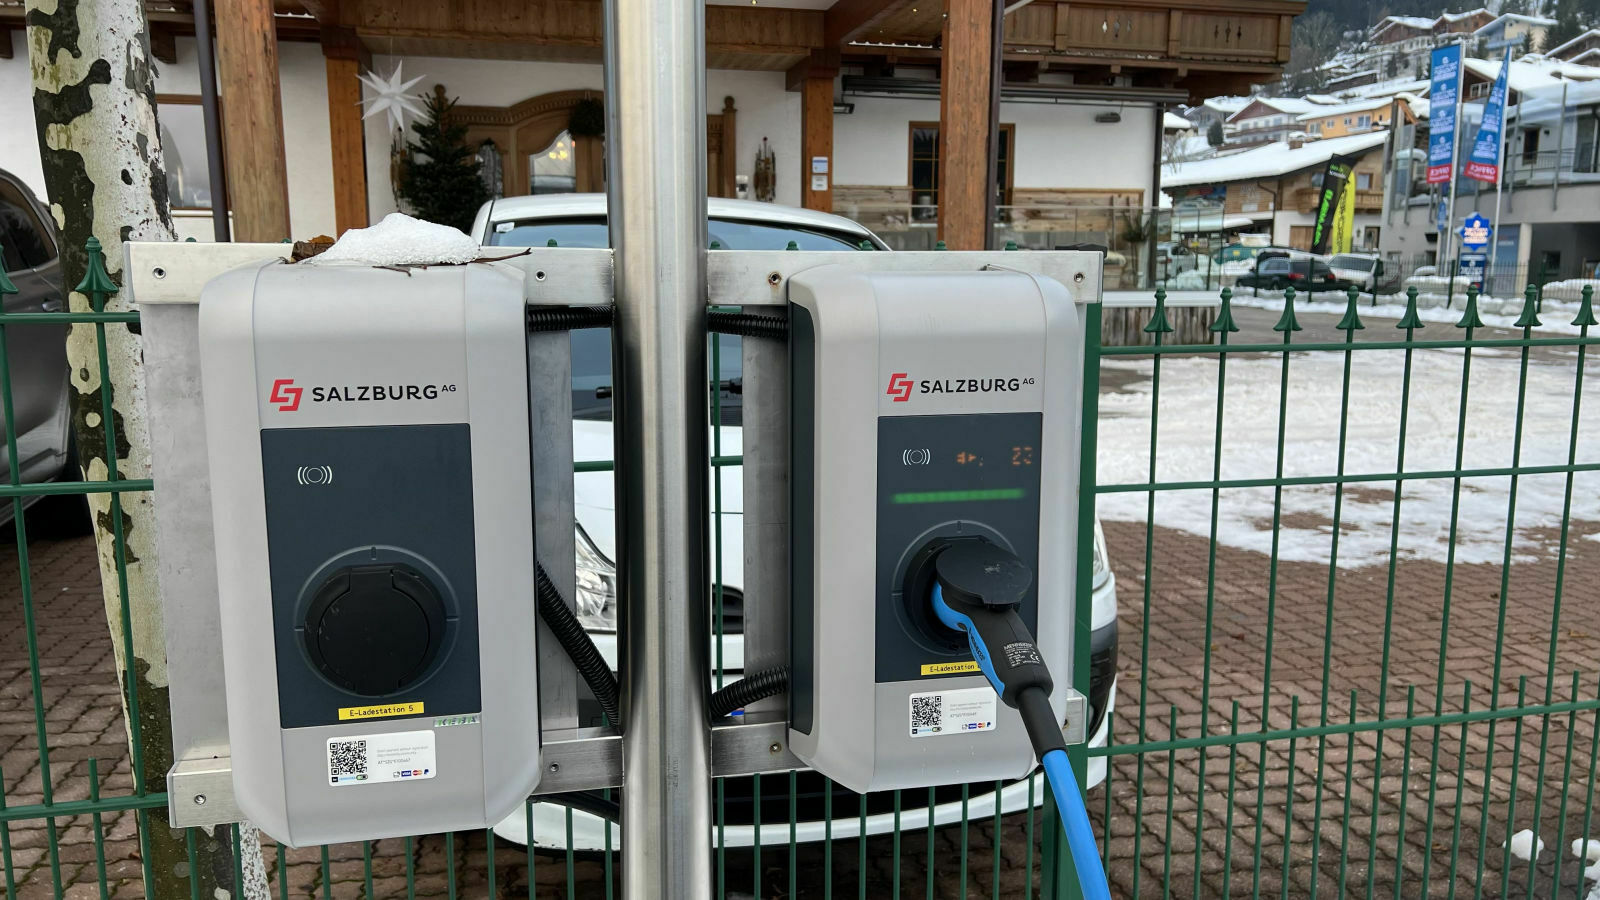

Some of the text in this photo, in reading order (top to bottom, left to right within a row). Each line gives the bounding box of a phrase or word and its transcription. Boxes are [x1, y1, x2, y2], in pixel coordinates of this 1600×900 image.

[312, 384, 457, 402] SALZBURG AG
[920, 377, 1035, 394] SALZBURG AG
[929, 663, 975, 673] E-Ladestation
[349, 704, 415, 717] E-Ladestation 5
